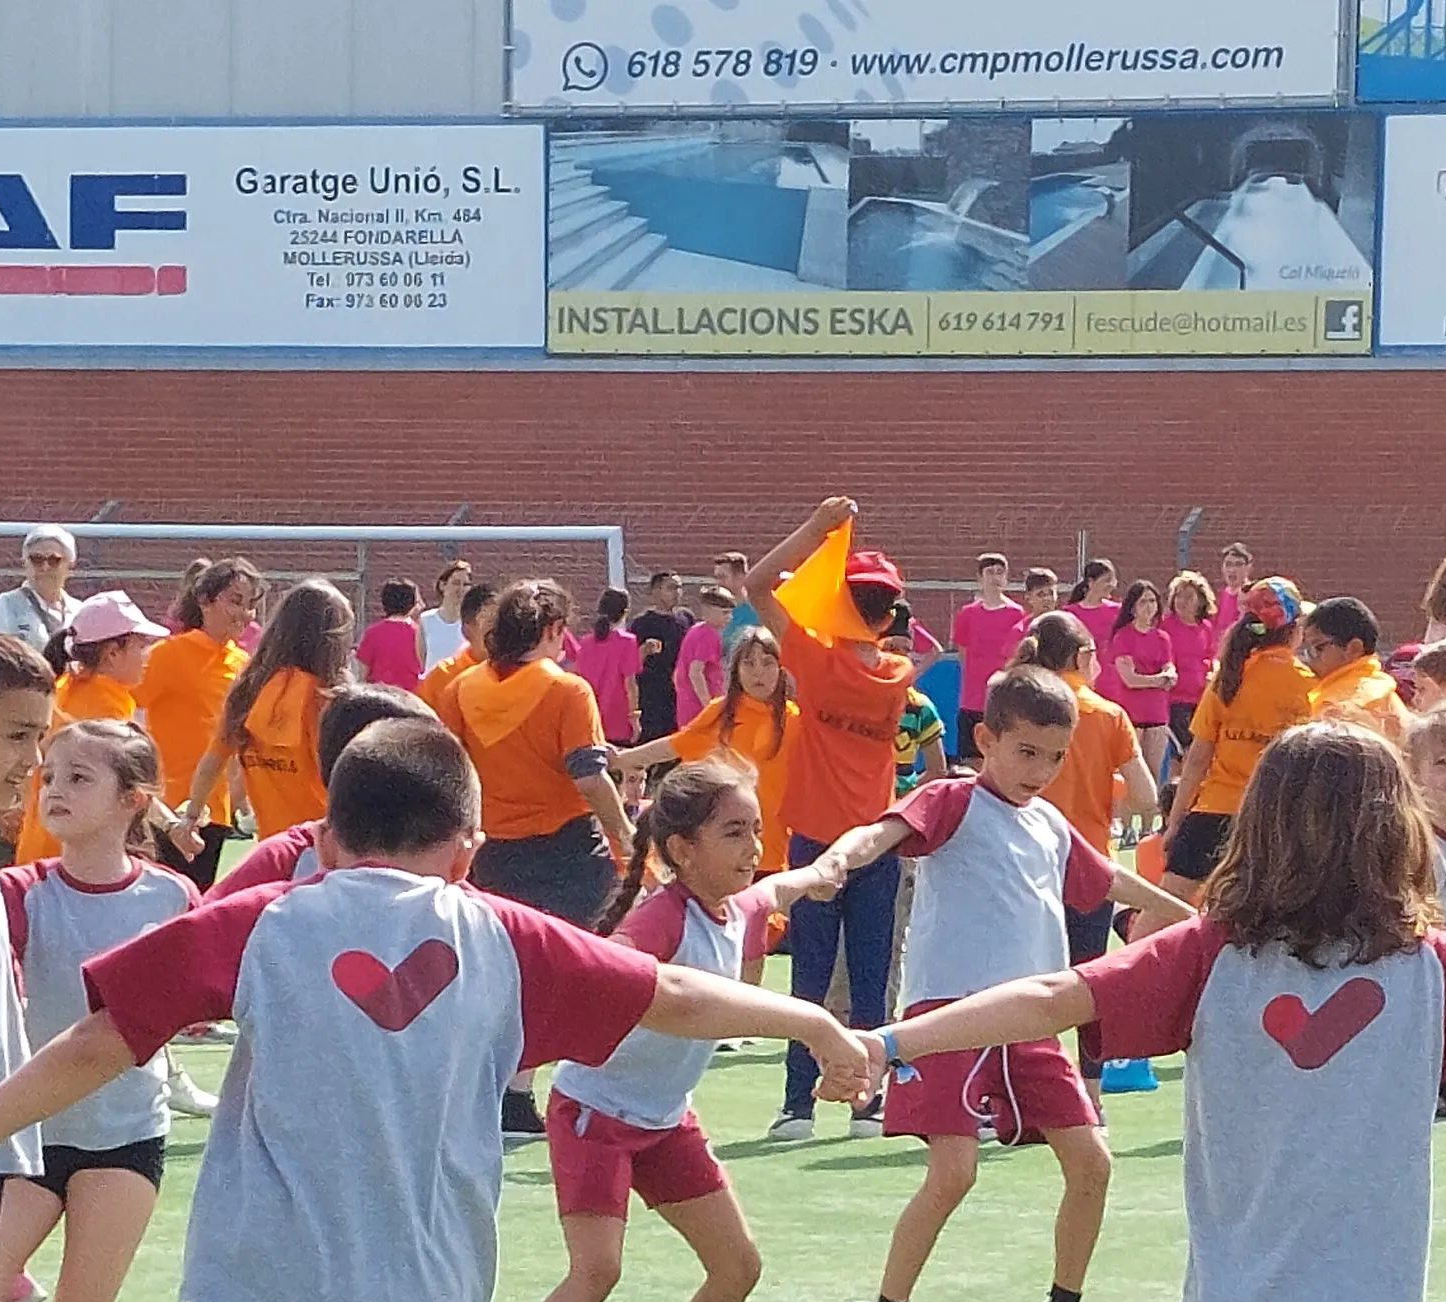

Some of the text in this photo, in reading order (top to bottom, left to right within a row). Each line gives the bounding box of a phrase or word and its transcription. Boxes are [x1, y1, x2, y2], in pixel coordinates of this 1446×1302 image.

[627, 50, 682, 78] 618
[691, 49, 753, 78] 578
[762, 48, 819, 77] 819
[852, 43, 1285, 80] www.cmpmollerussa.com
[235, 166, 521, 201] Garatge Unió, S.L.
[318, 208, 390, 224] Nacional
[343, 229, 464, 245] FONDARELLA
[283, 251, 403, 266] MOLLERUSSA
[829, 308, 914, 336] ESKA
[938, 312, 1065, 331] 619 614 791
[1087, 311, 1308, 334] fescude@hotmail.es
